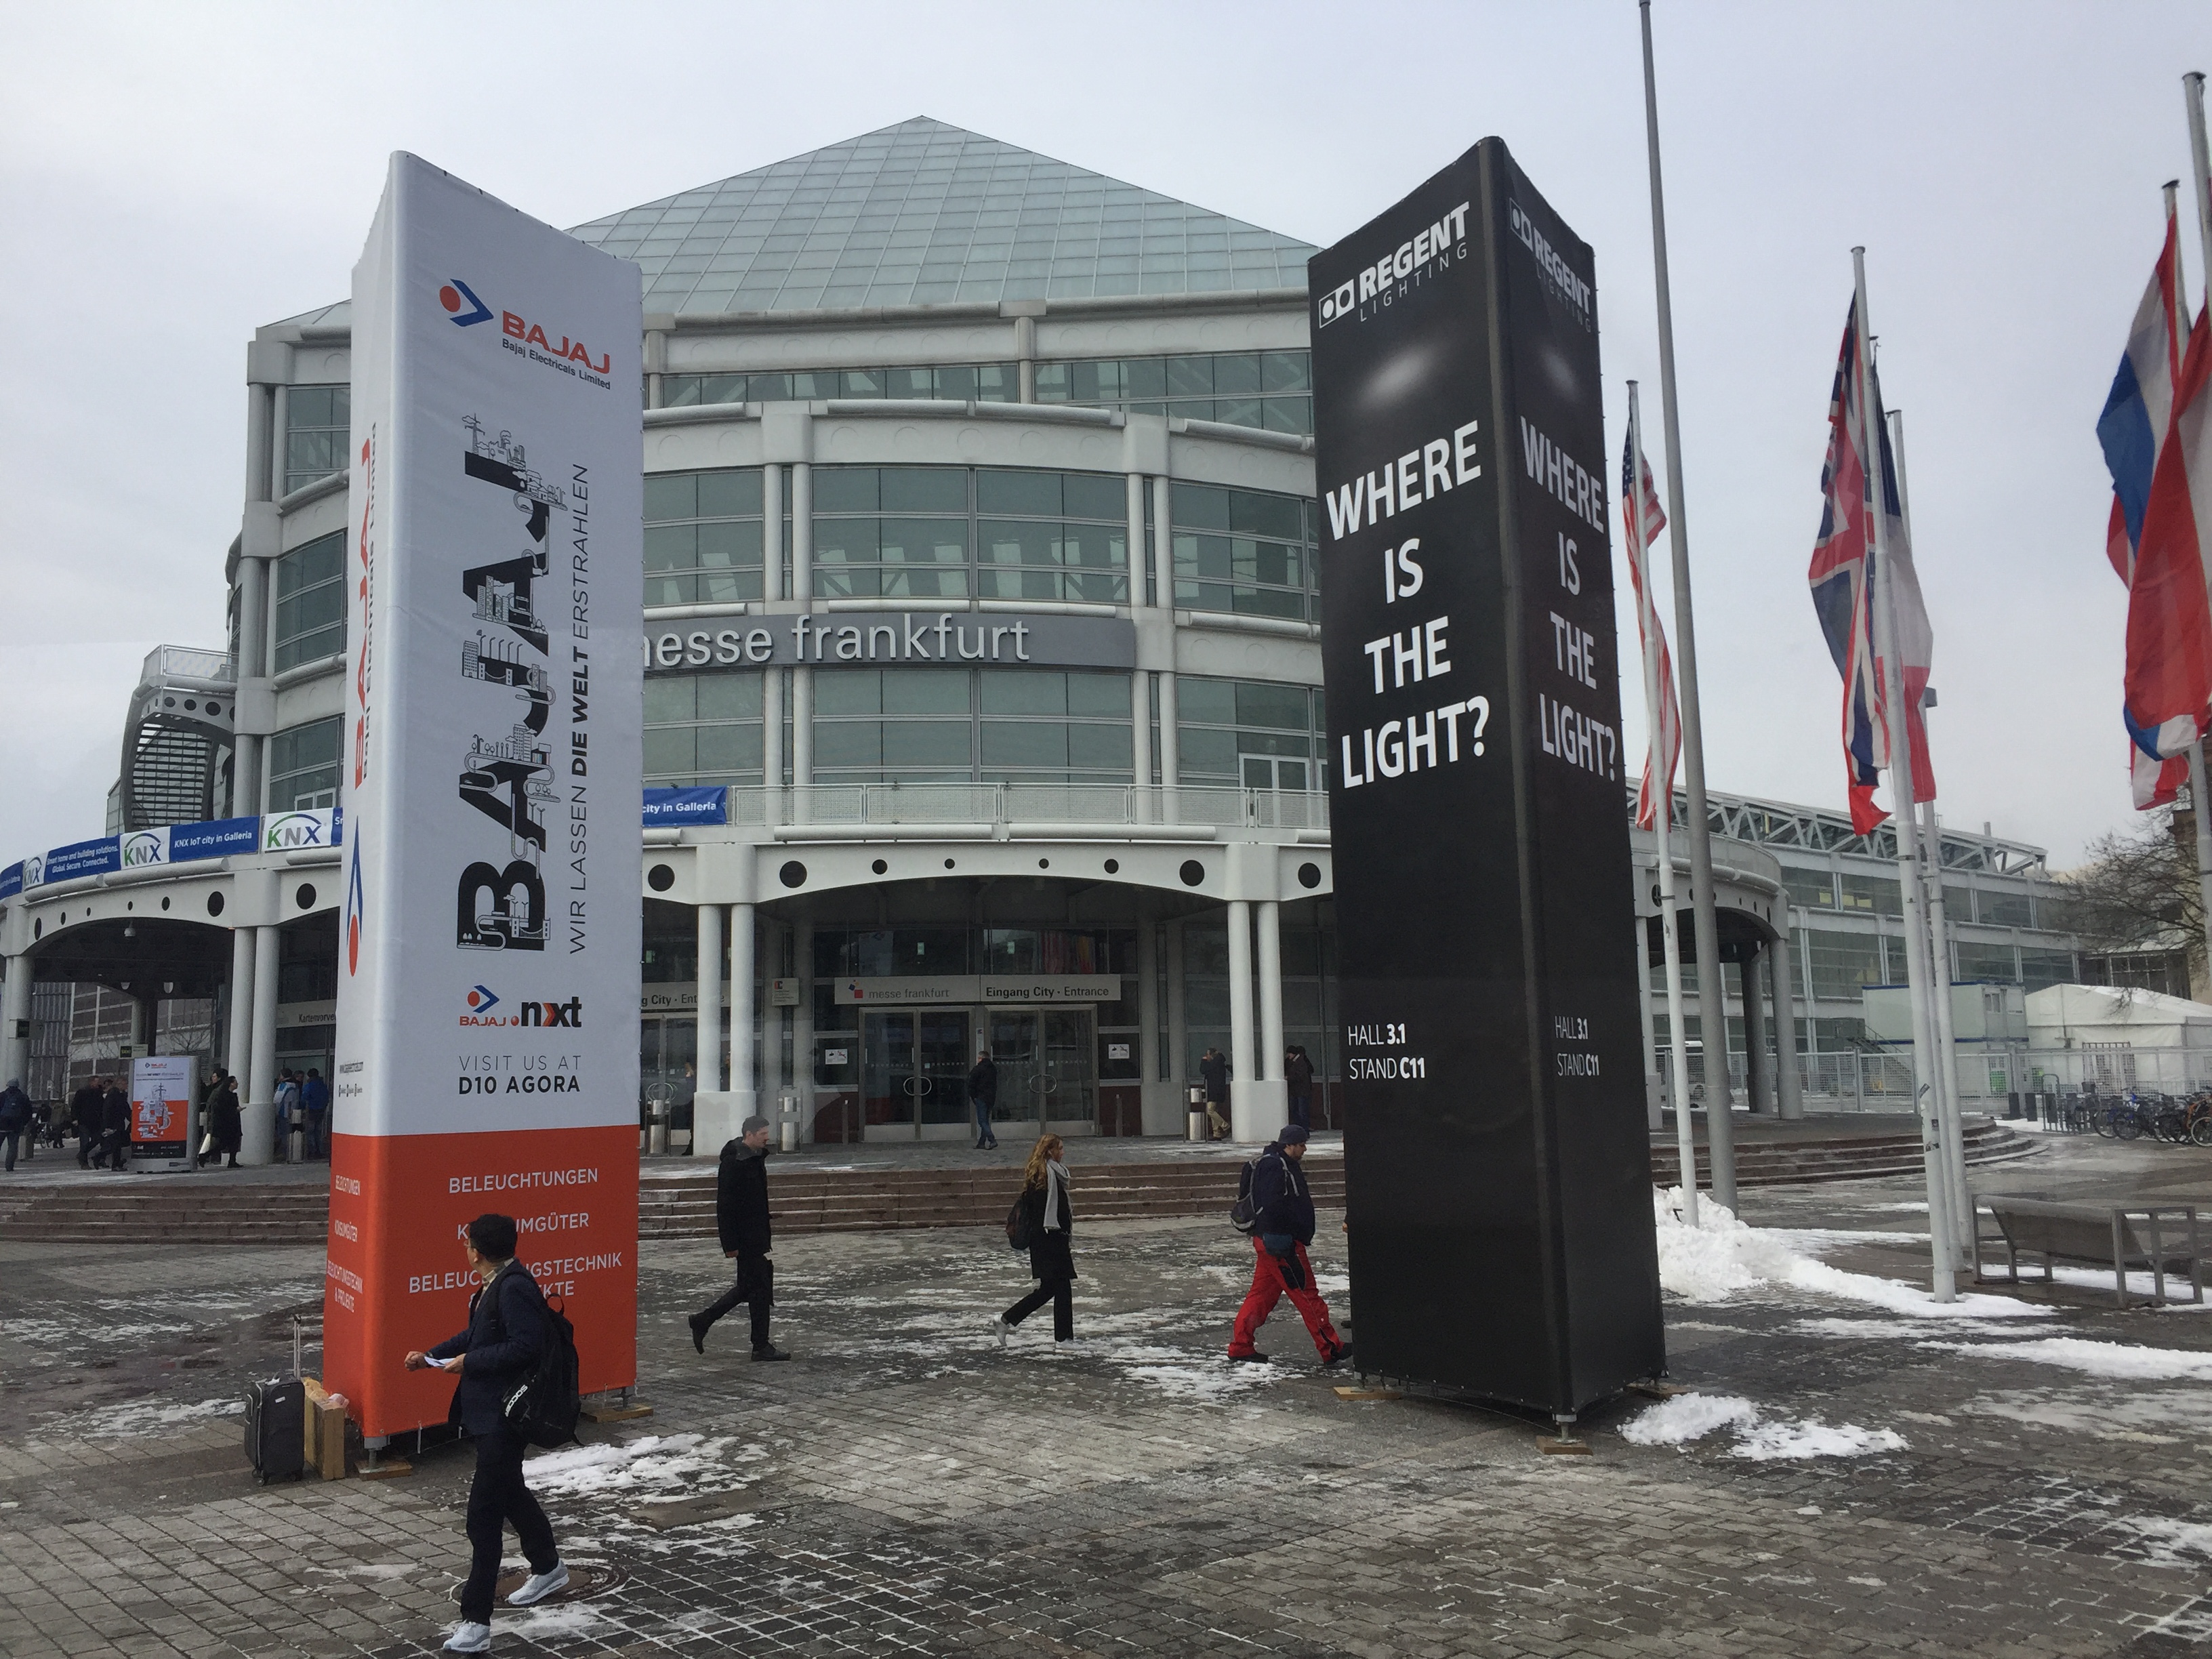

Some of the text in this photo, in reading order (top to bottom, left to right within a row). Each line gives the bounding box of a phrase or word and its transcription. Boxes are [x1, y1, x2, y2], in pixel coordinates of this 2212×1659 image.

[1359, 201, 1470, 304] REGENT
[1534, 226, 1591, 315] REGENT
[1359, 243, 1468, 323] LIGHTING
[1536, 263, 1591, 333] LIGHTING
[502, 310, 611, 375] BAJAJ
[502, 338, 611, 390] Bajaj Electricals Limited
[1326, 420, 1481, 541] WHERE
[1520, 415, 1605, 534] WHERE
[1385, 538, 1424, 604] IS
[1558, 532, 1580, 596] IS
[355, 438, 370, 790] BAJAJ
[792, 613, 1030, 661] frankfurt
[1364, 615, 1452, 695] THE
[1550, 611, 1597, 690] THE
[457, 450, 552, 951] BAJAJ
[570, 464, 588, 954] WIR LASSEN DIE WELT ERSTRAHLEN
[1342, 695, 1490, 788] LIGHT?
[1539, 693, 1616, 781] LIGHT?
[663, 803, 673, 812] in
[676, 802, 716, 812] Galleria
[124, 844, 161, 867] KNX
[175, 831, 253, 848] KNX IoT city in Galleria
[267, 825, 322, 848] KNX
[651, 994, 672, 1006] City
[869, 987, 949, 999] messe frankfurt
[986, 986, 1109, 998] Eingang City Entrance
[459, 1016, 507, 1027] BAJAJ
[1348, 1023, 1406, 1046] HALL 3.1
[1555, 1015, 1589, 1040] HALL 3.1
[459, 1054, 581, 1071] VISIT US AT
[459, 1075, 581, 1094] D10 AGORA
[1349, 1057, 1425, 1080] STAND C11
[1557, 1053, 1599, 1076] STAND C11
[449, 1168, 598, 1194] BELEUCHTUNGEN
